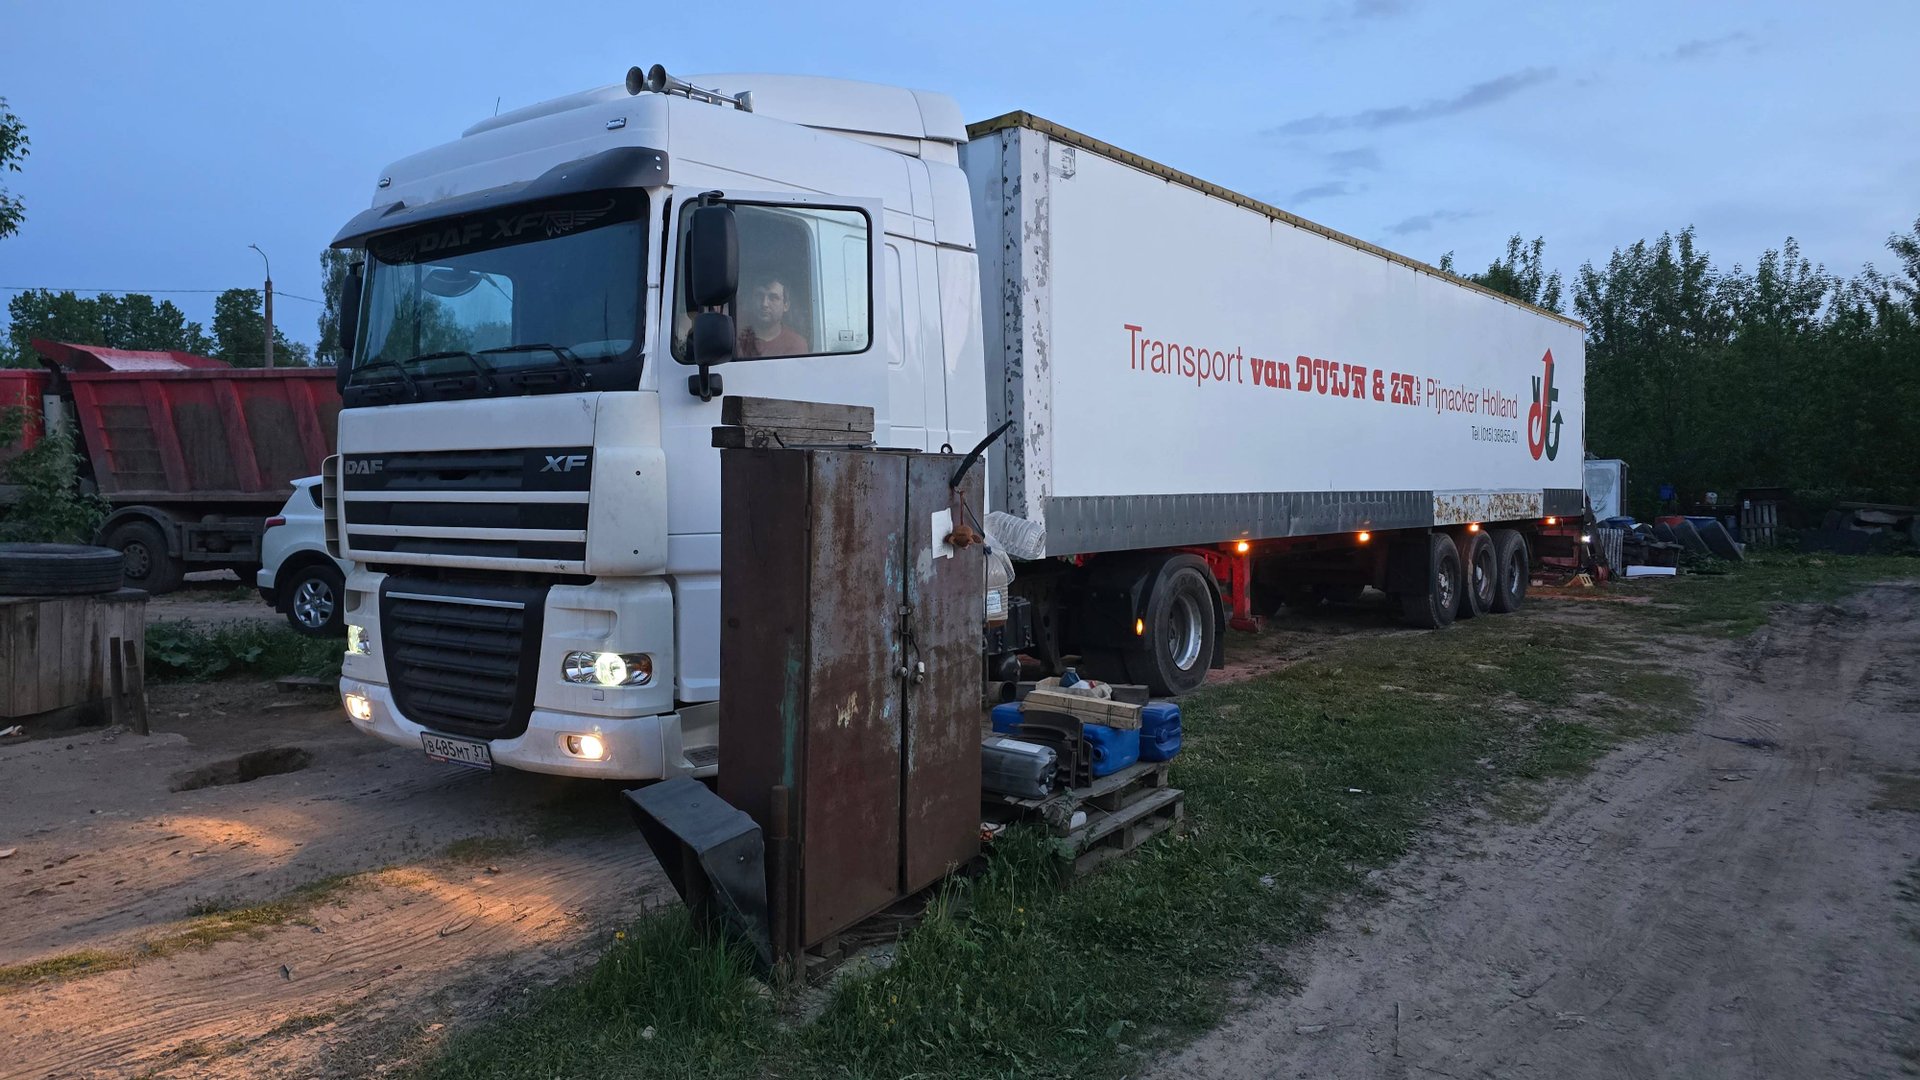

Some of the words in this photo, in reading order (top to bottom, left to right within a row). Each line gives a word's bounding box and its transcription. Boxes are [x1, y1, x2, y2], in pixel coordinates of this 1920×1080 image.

[419, 224, 484, 253] DAF
[491, 213, 545, 240] XF
[1124, 324, 1243, 386] Transport
[1251, 357, 1292, 390] van
[1297, 355, 1367, 399] DUIJN
[1373, 369, 1385, 402] &
[1427, 378, 1479, 414] Pijnacker
[1482, 386, 1518, 419] Holland
[344, 459, 384, 475] DAF
[539, 455, 588, 473] XF
